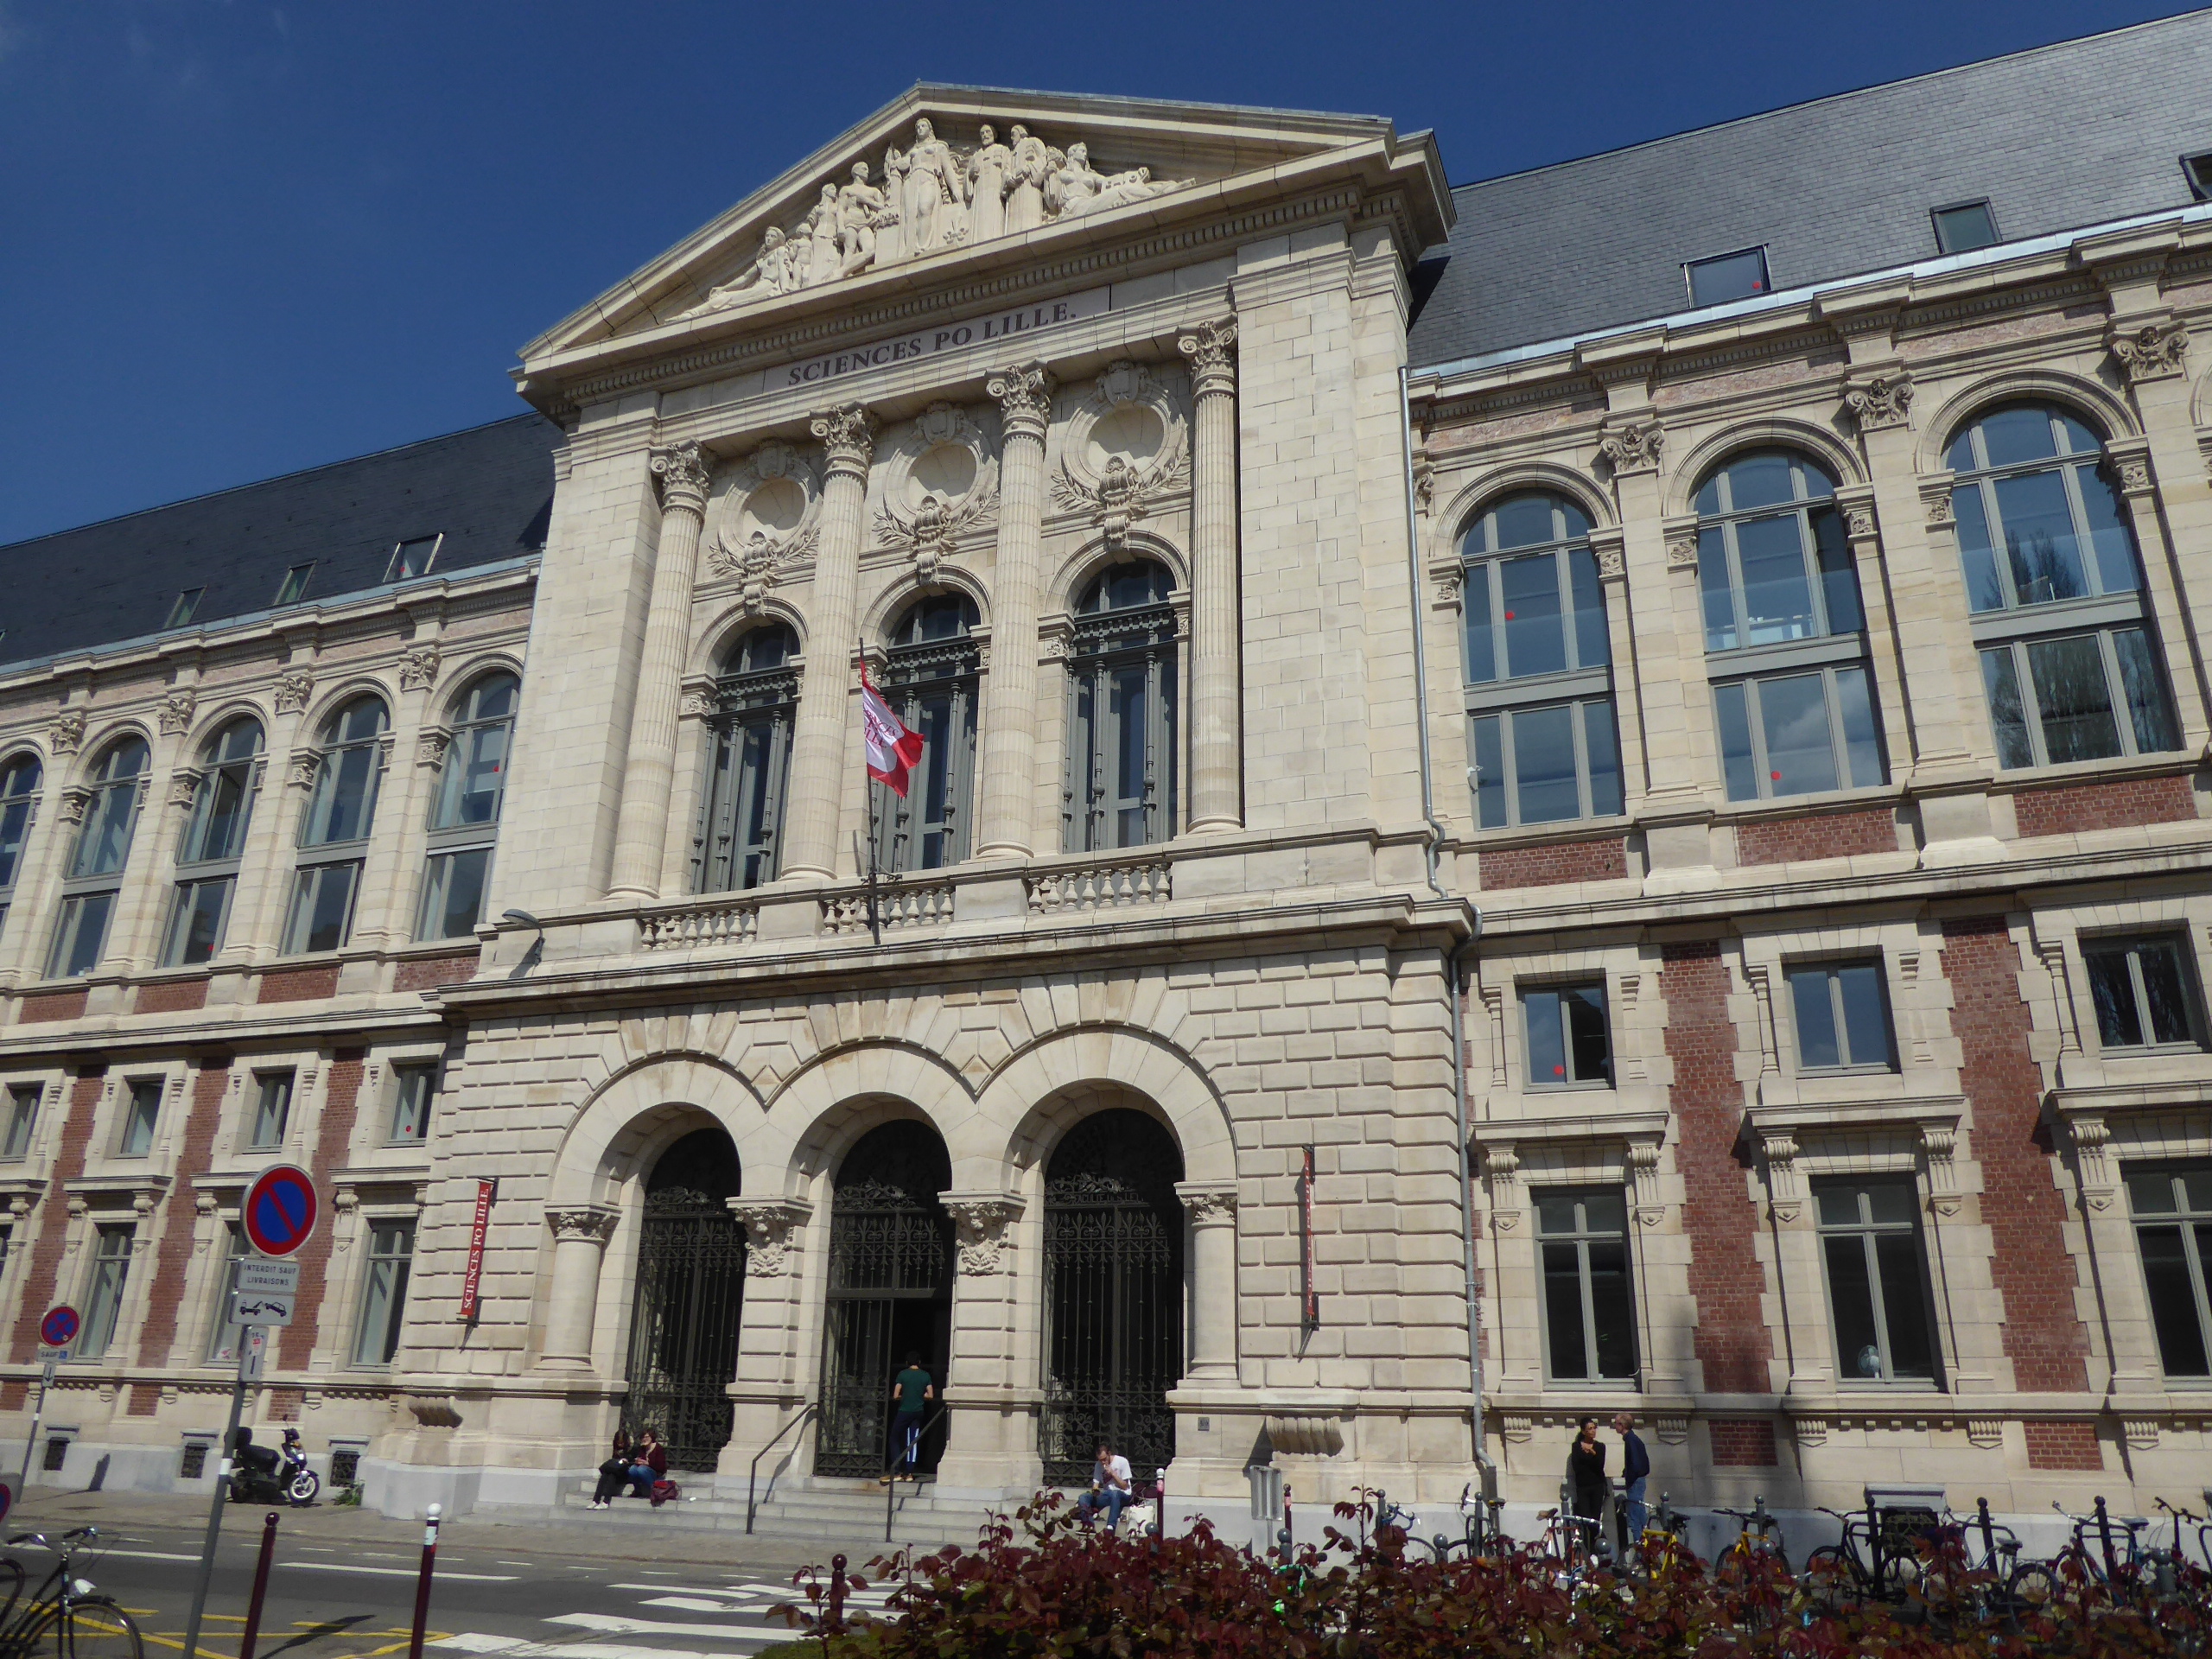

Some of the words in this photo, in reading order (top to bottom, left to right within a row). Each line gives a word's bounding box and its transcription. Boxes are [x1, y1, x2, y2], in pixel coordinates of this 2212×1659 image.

[788, 338, 921, 386] SCIENCES
[934, 327, 971, 351] PO
[982, 302, 1077, 340] LILLE.
[244, 1264, 276, 1273] INTERDIT
[247, 1276, 289, 1286] LIVRAISONS
[464, 1249, 480, 1309] SCIENCES
[473, 1228, 483, 1246] PO
